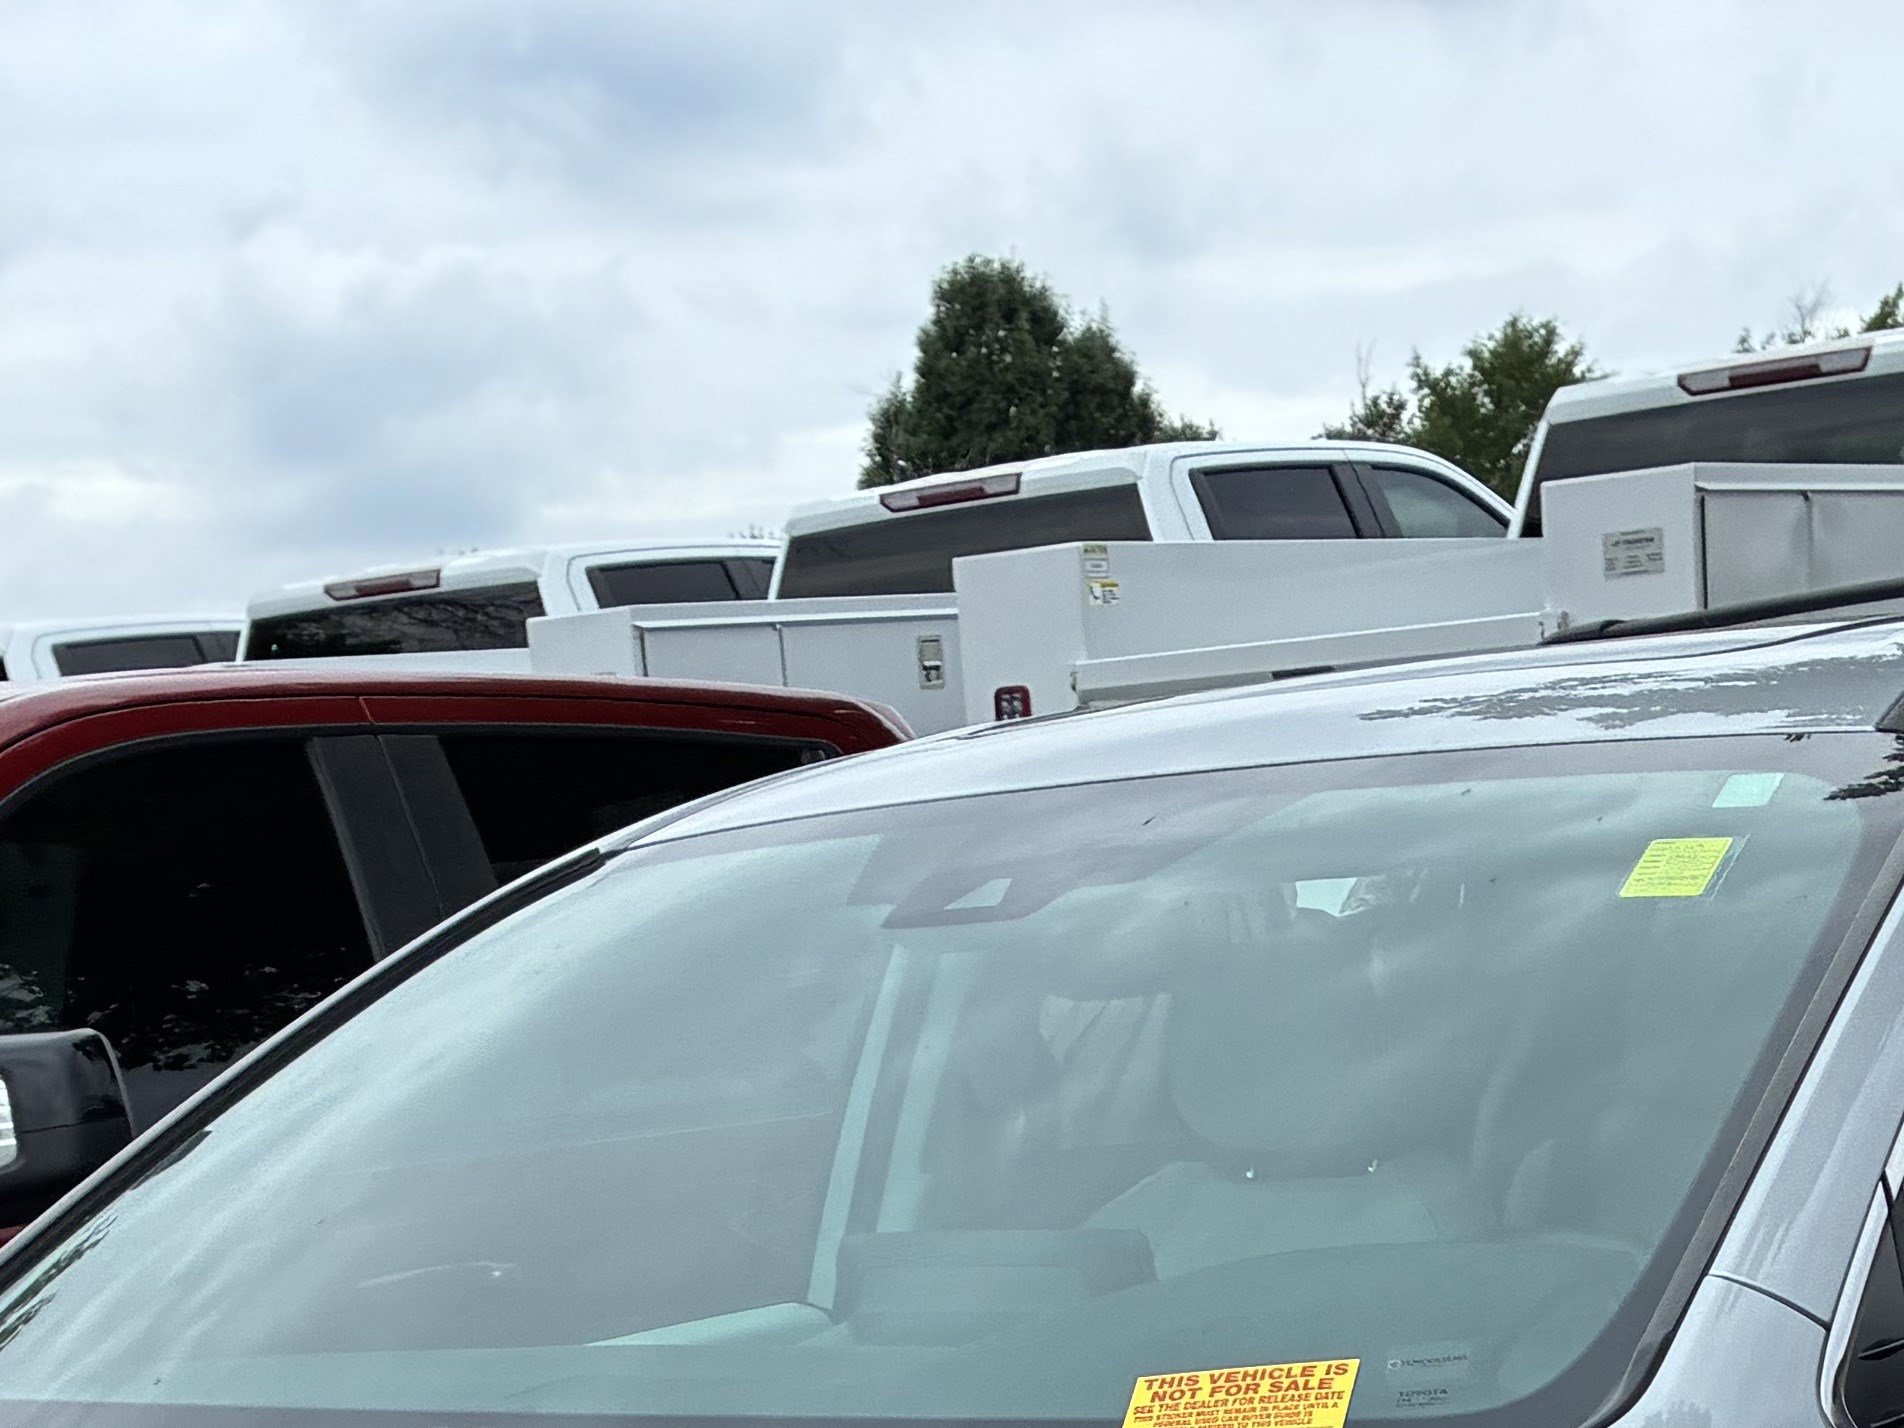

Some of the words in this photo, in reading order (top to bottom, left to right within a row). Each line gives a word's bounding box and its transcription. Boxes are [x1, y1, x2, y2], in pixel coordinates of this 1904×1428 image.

[1144, 1375, 1200, 1391] THIS
[1210, 1366, 1317, 1385] VEHICLE
[1325, 1363, 1349, 1376] IS
[1134, 1405, 1155, 1415] SEE
[1159, 1402, 1182, 1412] THE
[1183, 1398, 1229, 1410] DEALER
[1232, 1396, 1255, 1406] FOR
[1258, 1393, 1311, 1404] RELEASE
[1314, 1391, 1345, 1401] DATE
[1150, 1387, 1203, 1403] NOT
[1209, 1383, 1261, 1398] FOR
[1268, 1378, 1334, 1393] SALE
